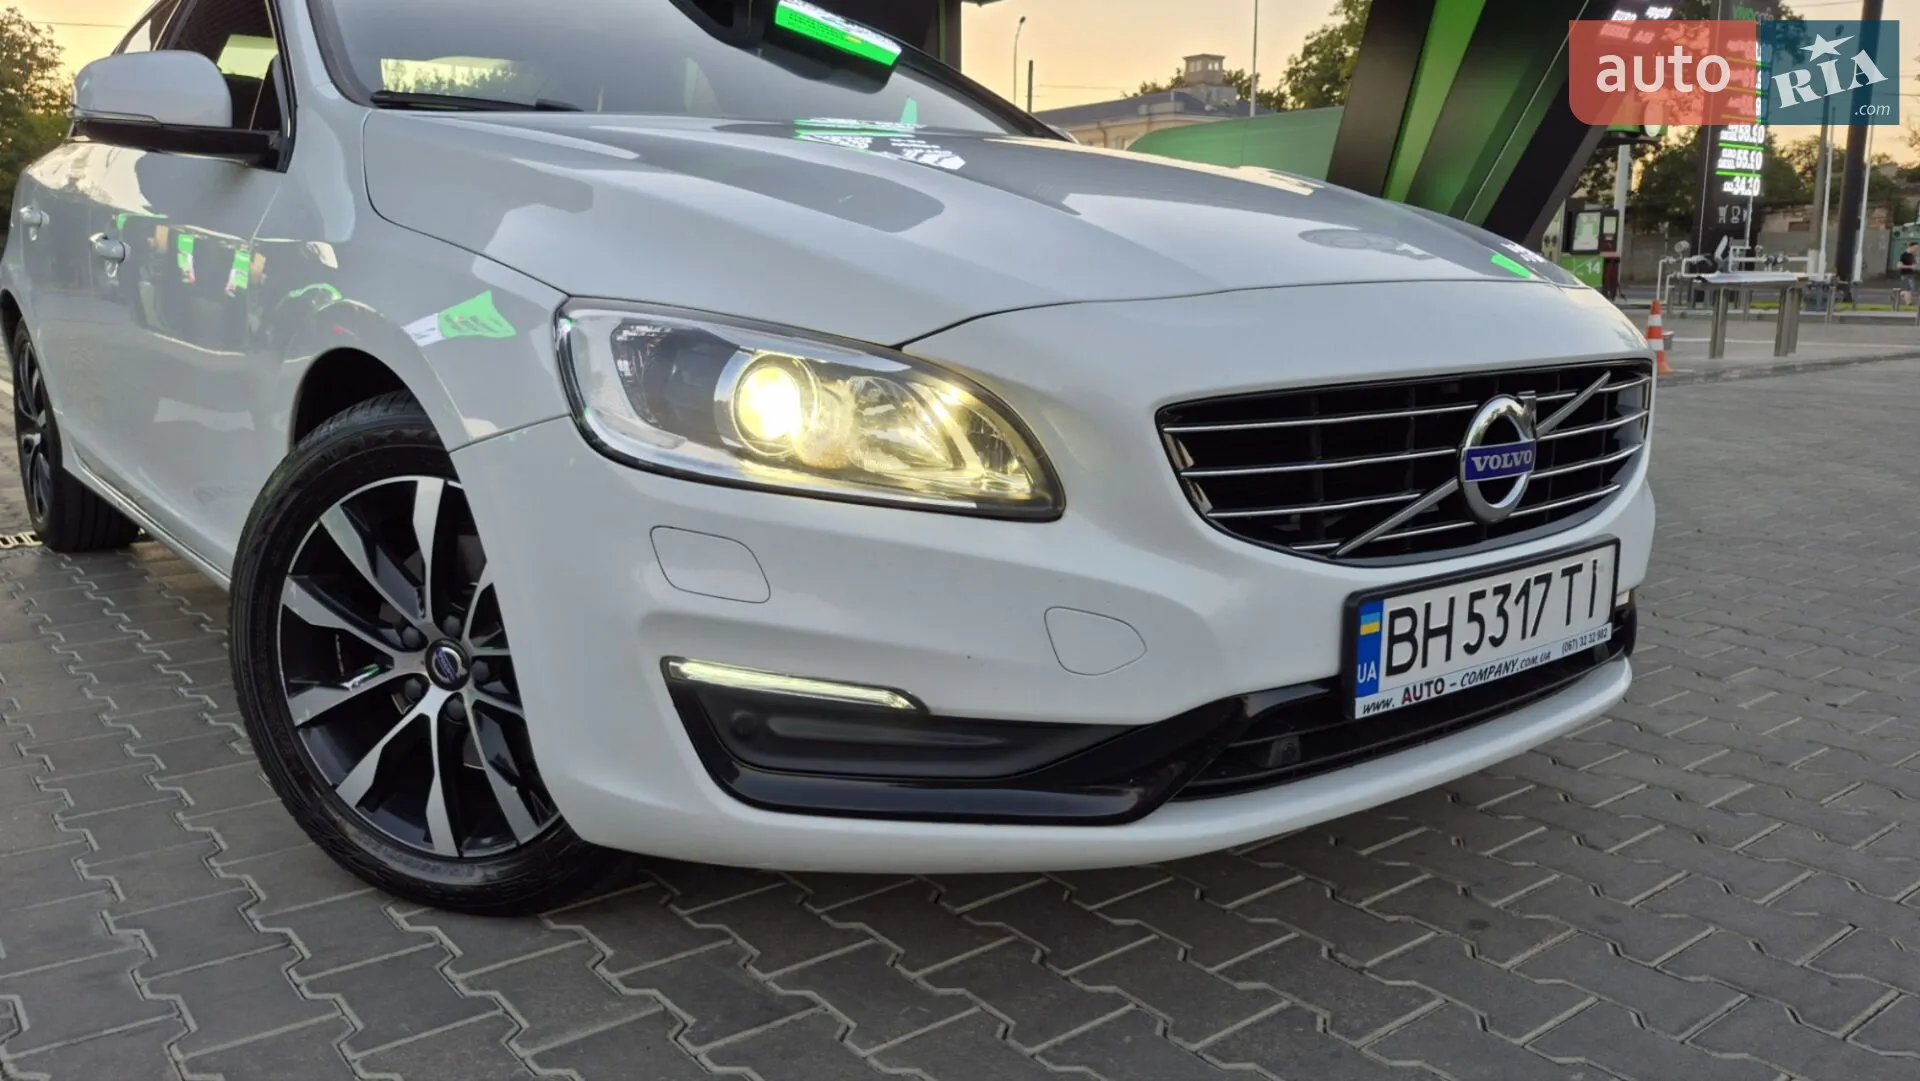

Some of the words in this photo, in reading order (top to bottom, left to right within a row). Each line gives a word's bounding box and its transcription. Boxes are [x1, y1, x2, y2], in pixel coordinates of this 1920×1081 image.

[1587, 261, 1601, 274] 14
[1471, 449, 1533, 472] VOLVO
[1385, 596, 1455, 677] BH
[1463, 572, 1553, 655] 5317
[1357, 661, 1377, 684] UA
[1401, 678, 1445, 705] AUTO
